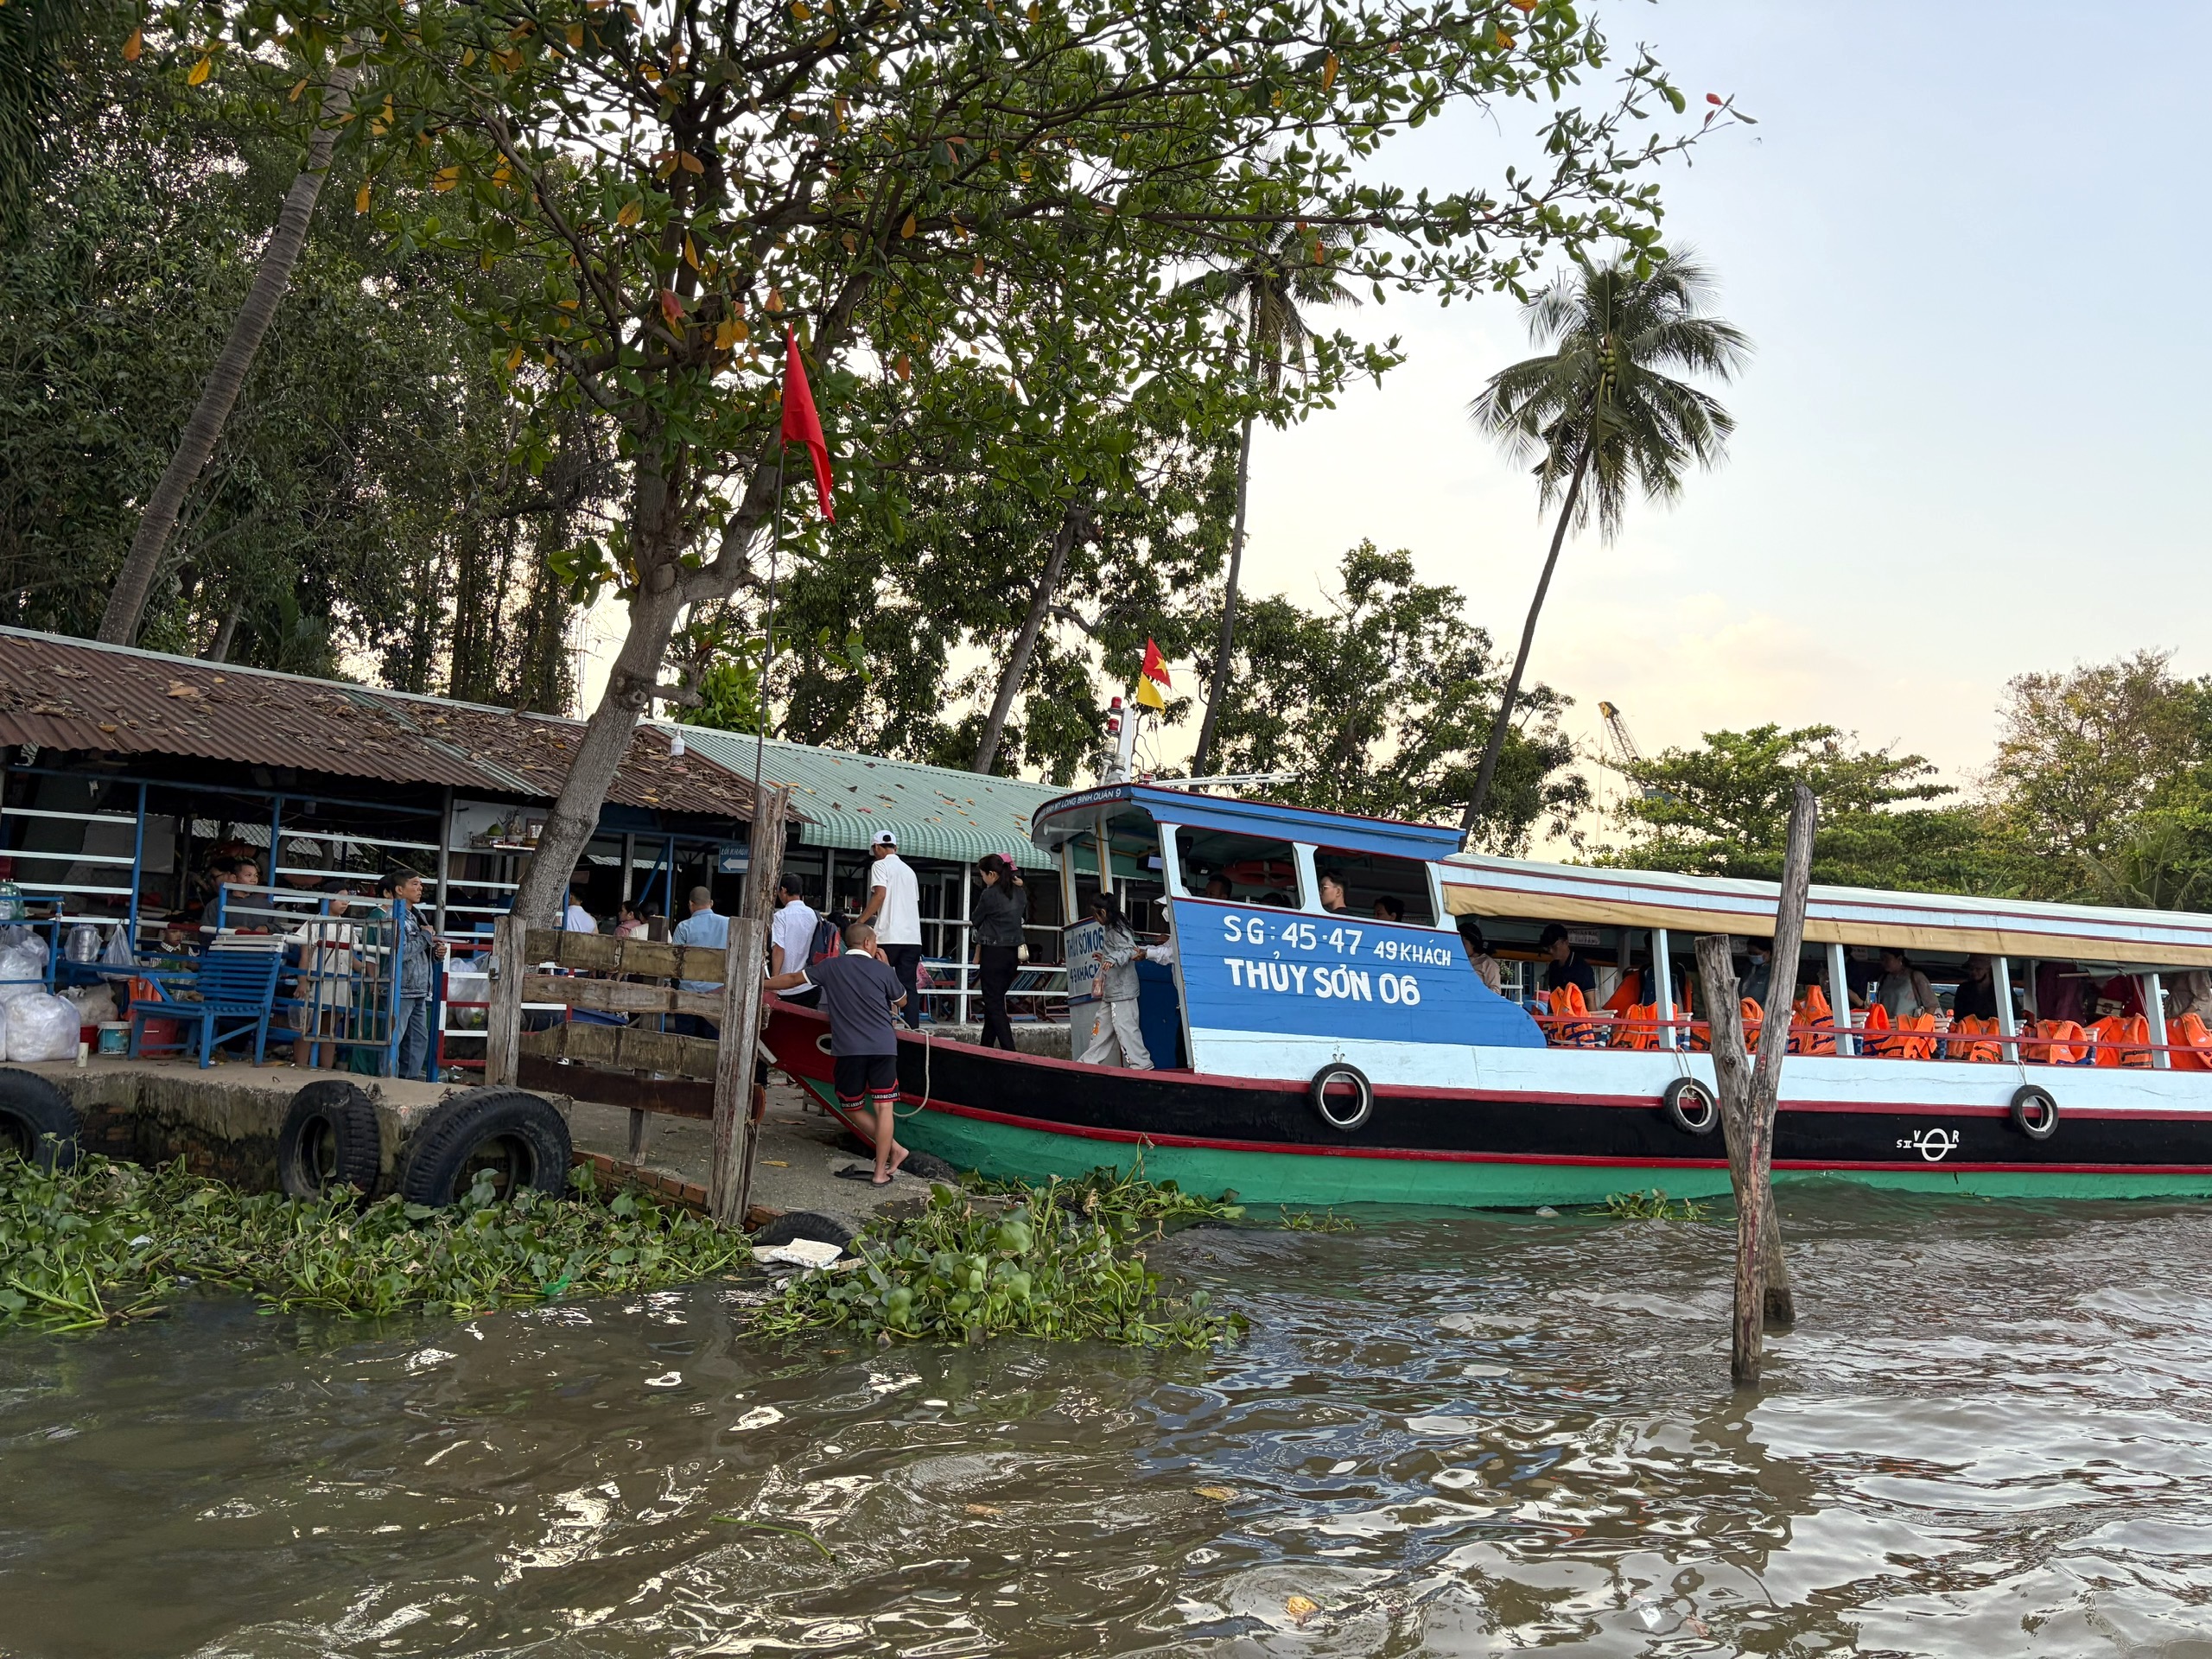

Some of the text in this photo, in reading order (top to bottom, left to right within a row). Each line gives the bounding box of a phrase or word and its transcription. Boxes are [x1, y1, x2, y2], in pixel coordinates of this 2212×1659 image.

[1061, 797, 1077, 808] LONG
[1116, 788, 1122, 798] 9
[1092, 926, 1104, 951] 06
[1373, 940, 1398, 961] 49
[1400, 939, 1452, 966] KHÁCH
[1224, 950, 1421, 1006] THỦY SƠN 06
[1913, 1129, 1922, 1142] V
[1952, 1129, 1960, 1143] R
